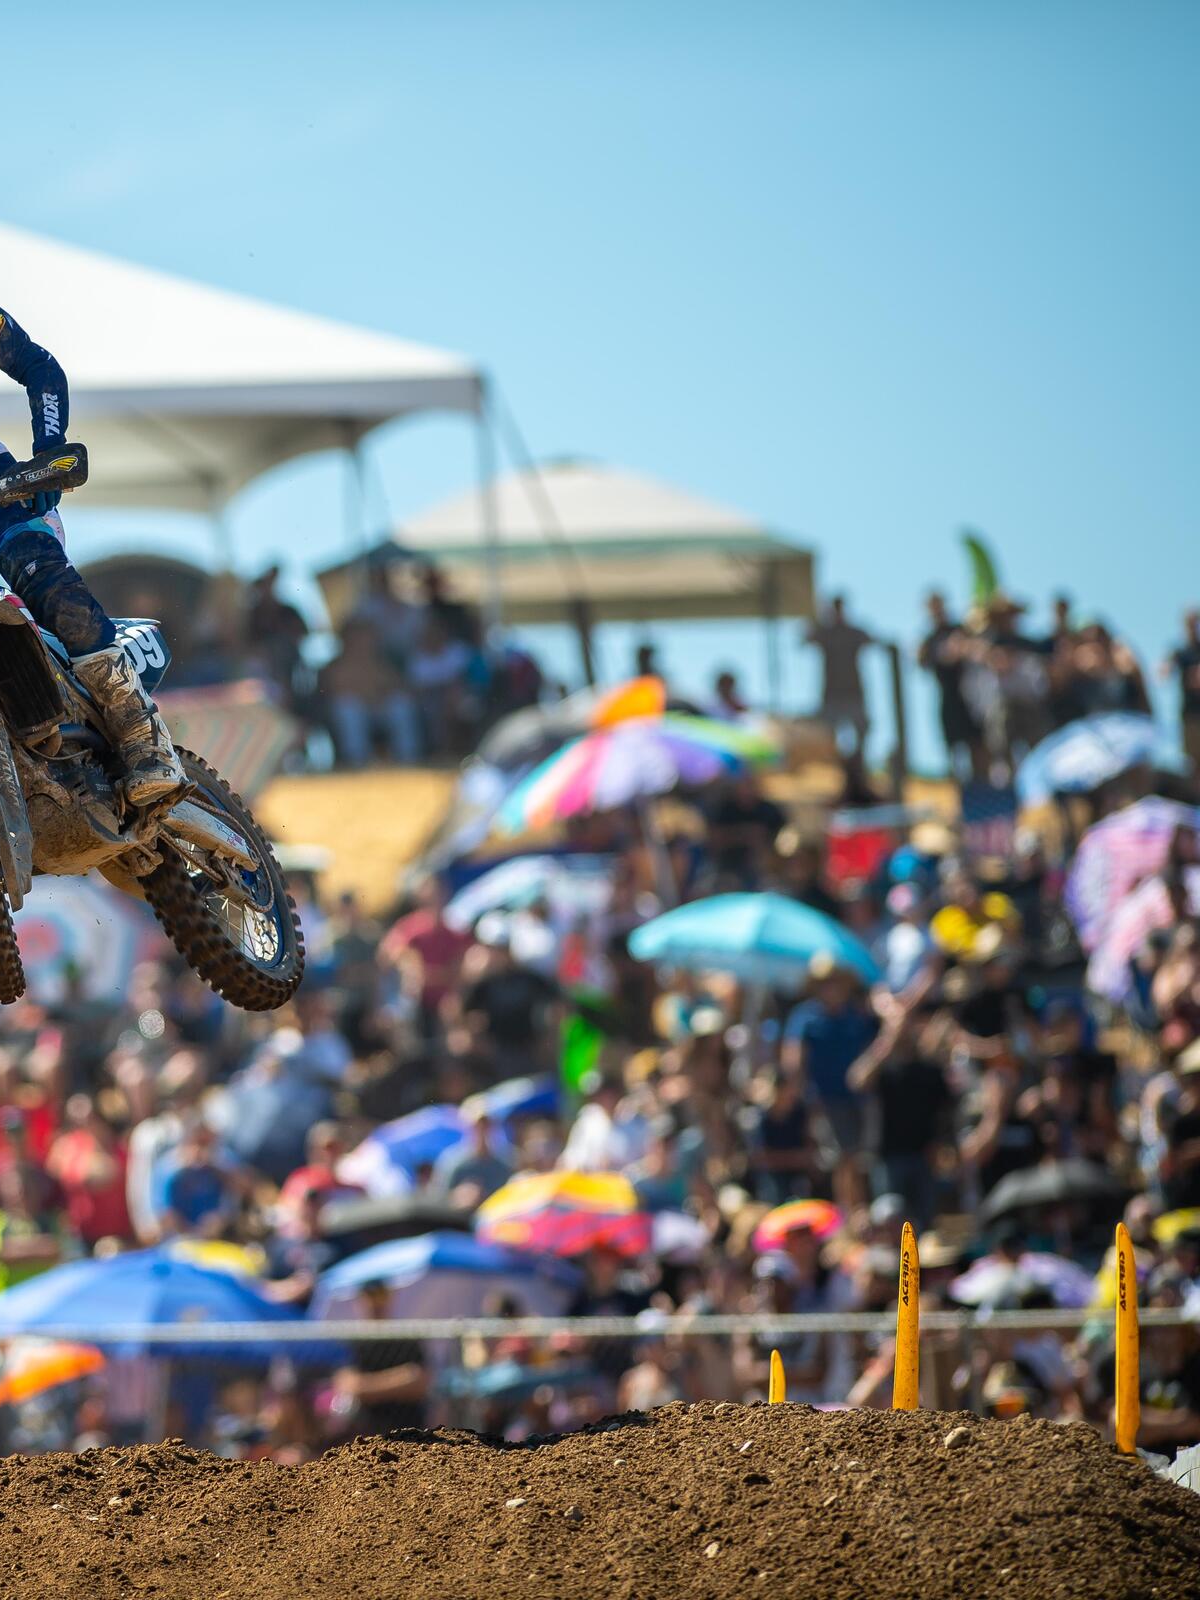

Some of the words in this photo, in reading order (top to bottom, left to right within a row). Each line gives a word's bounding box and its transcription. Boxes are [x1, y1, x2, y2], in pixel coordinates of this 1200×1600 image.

[42, 392, 60, 436] THOR
[902, 1251, 910, 1306] ACERBIS
[1119, 1251, 1127, 1312] ACERBIS
